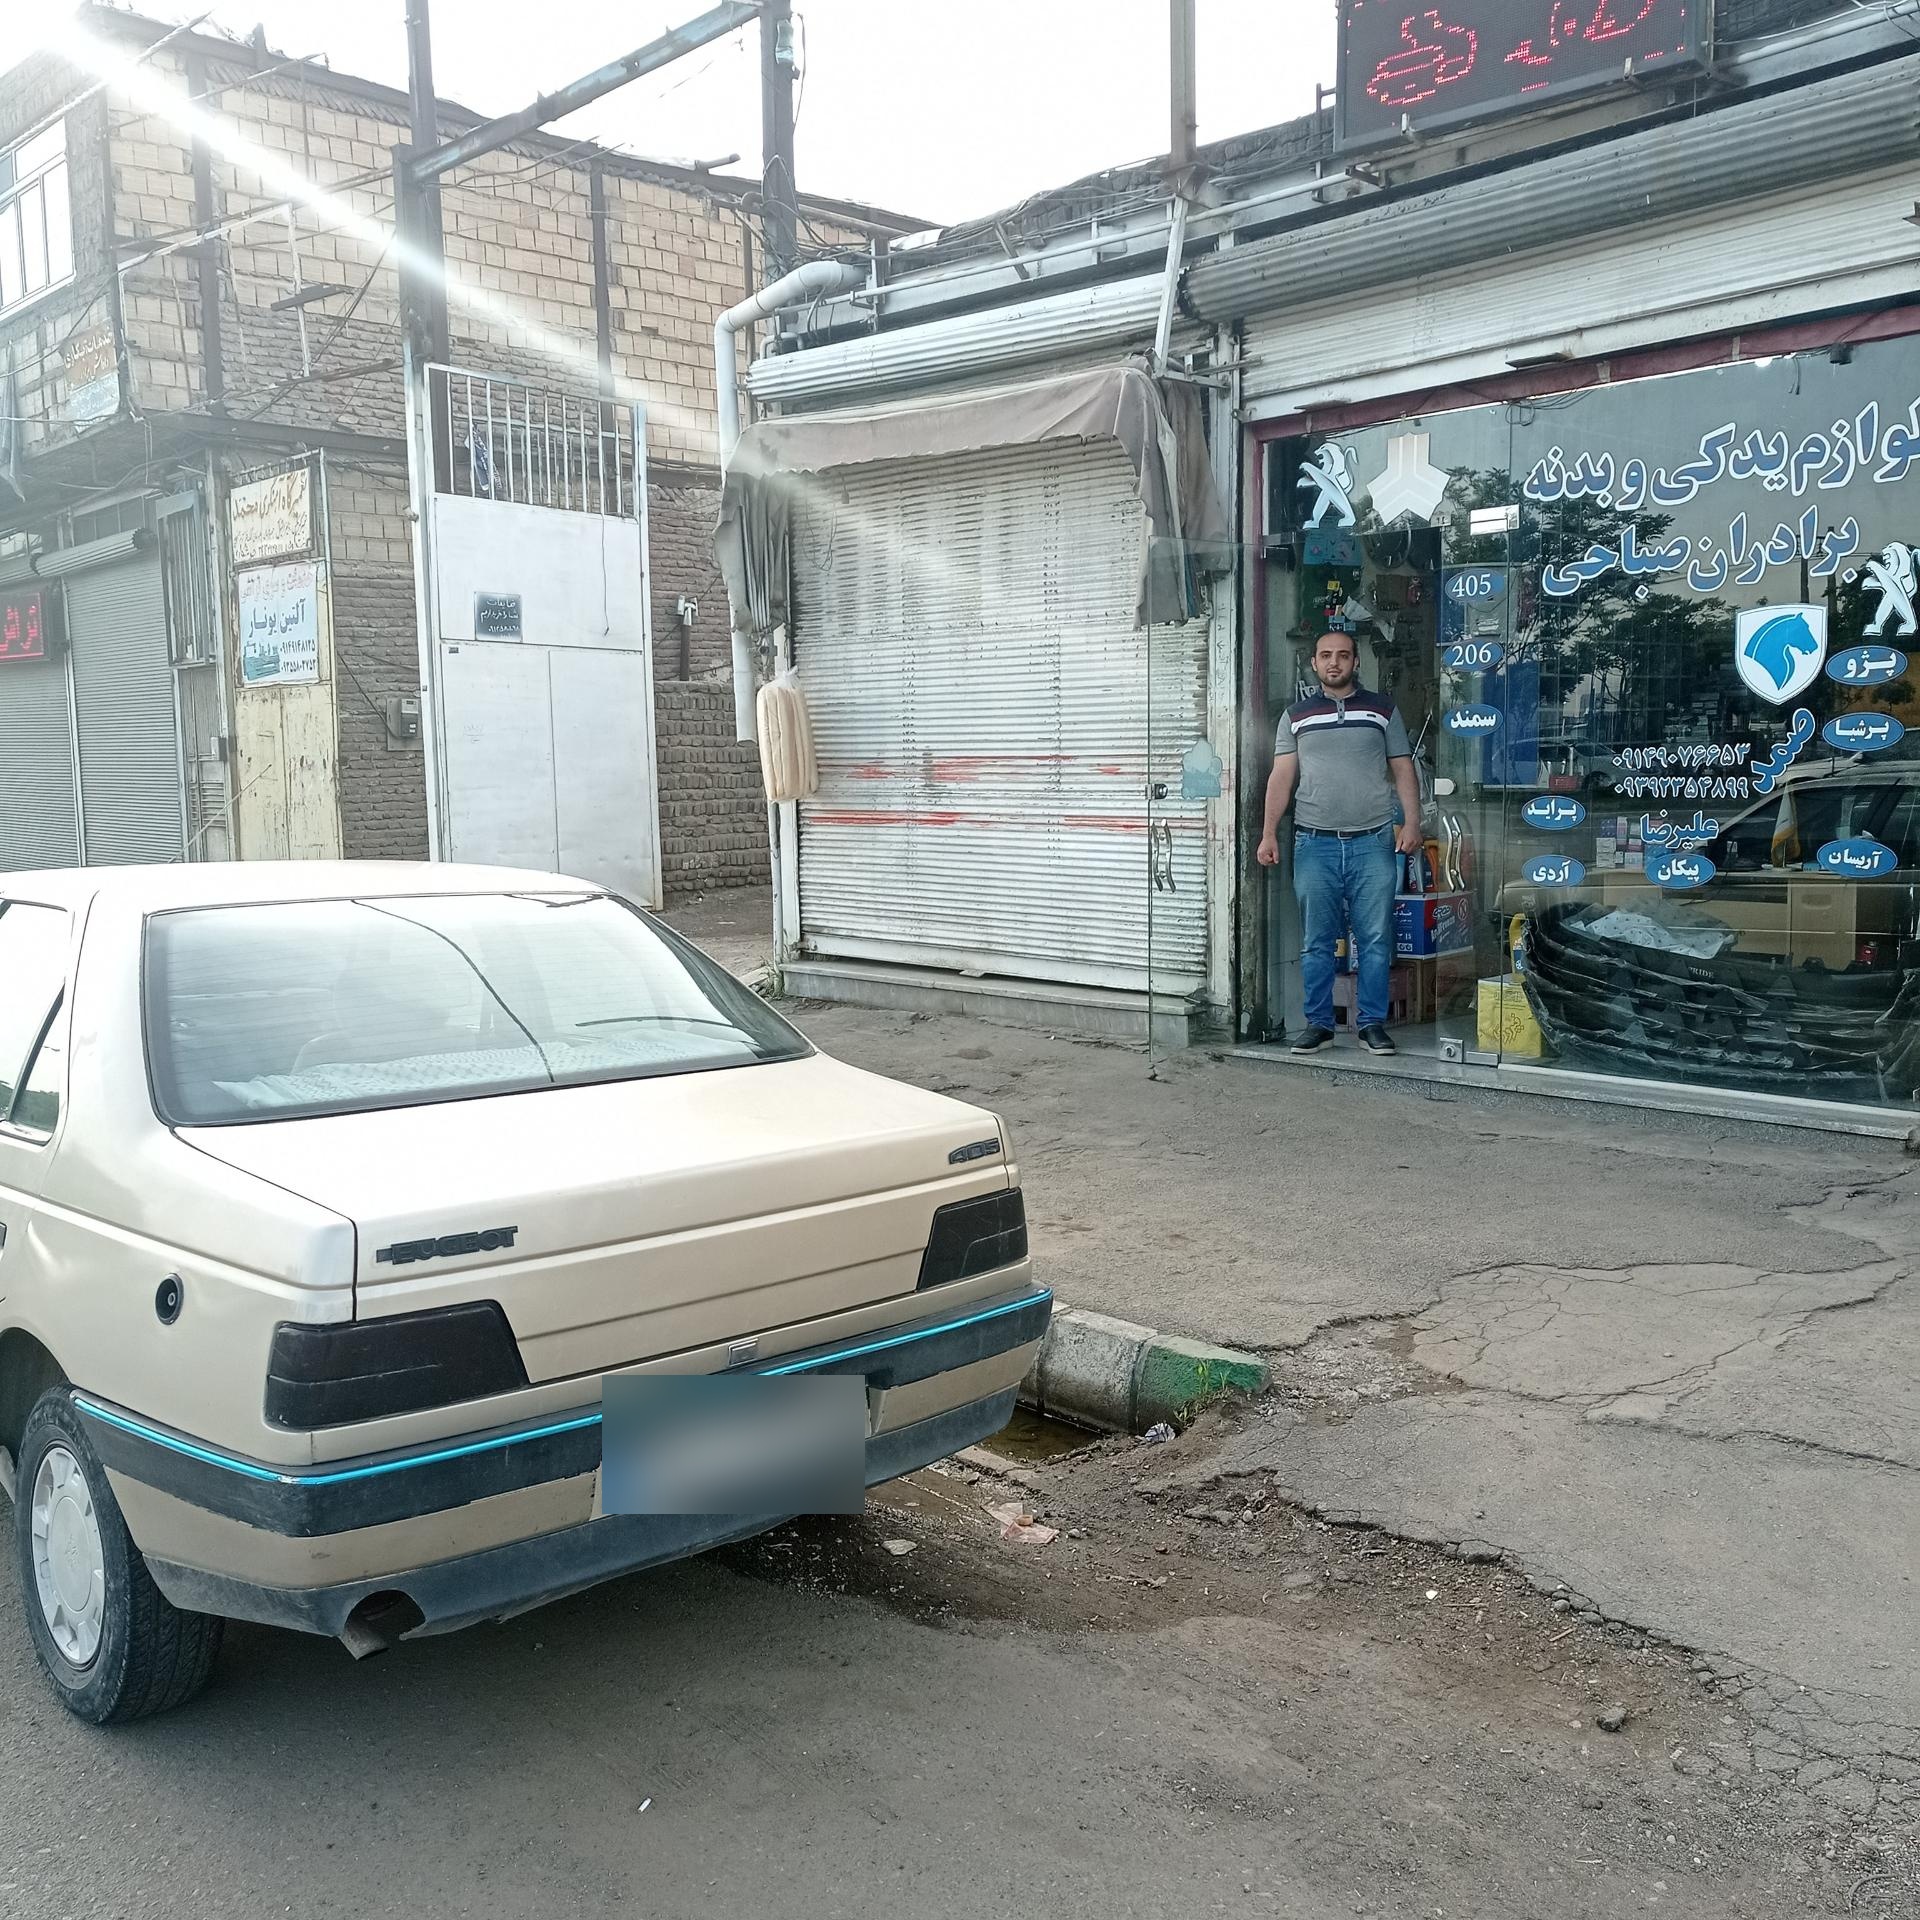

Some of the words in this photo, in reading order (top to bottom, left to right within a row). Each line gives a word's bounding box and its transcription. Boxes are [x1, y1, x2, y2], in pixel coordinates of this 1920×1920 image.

[1523, 445, 1615, 509] بدنه
[1651, 422, 1789, 506] یدکی
[1616, 458, 1647, 511] و
[1541, 524, 1691, 599] صباحی
[1688, 504, 1860, 592] برادران
[1452, 573, 1491, 598] 405
[248, 606, 277, 638] یونار
[280, 598, 306, 634] آلتین
[1452, 642, 1492, 666] 206
[1843, 650, 1897, 679] پژو
[1450, 710, 1496, 729] سمند
[1835, 719, 1890, 741] پرشیا
[1612, 743, 1751, 769] ۰۹۱۴۹۰۷۶۶۵۳
[1751, 708, 1815, 794] صمد
[1614, 776, 1749, 799] ۰۹۳۹۲۳۵۴۸۹۹
[1527, 799, 1577, 821] پراید
[1640, 809, 1719, 849] علیرضا
[1532, 860, 1571, 882] آردی
[1657, 859, 1700, 882] پیکان
[1828, 848, 1884, 869] آریسان
[948, 1137, 1000, 1165] 405
